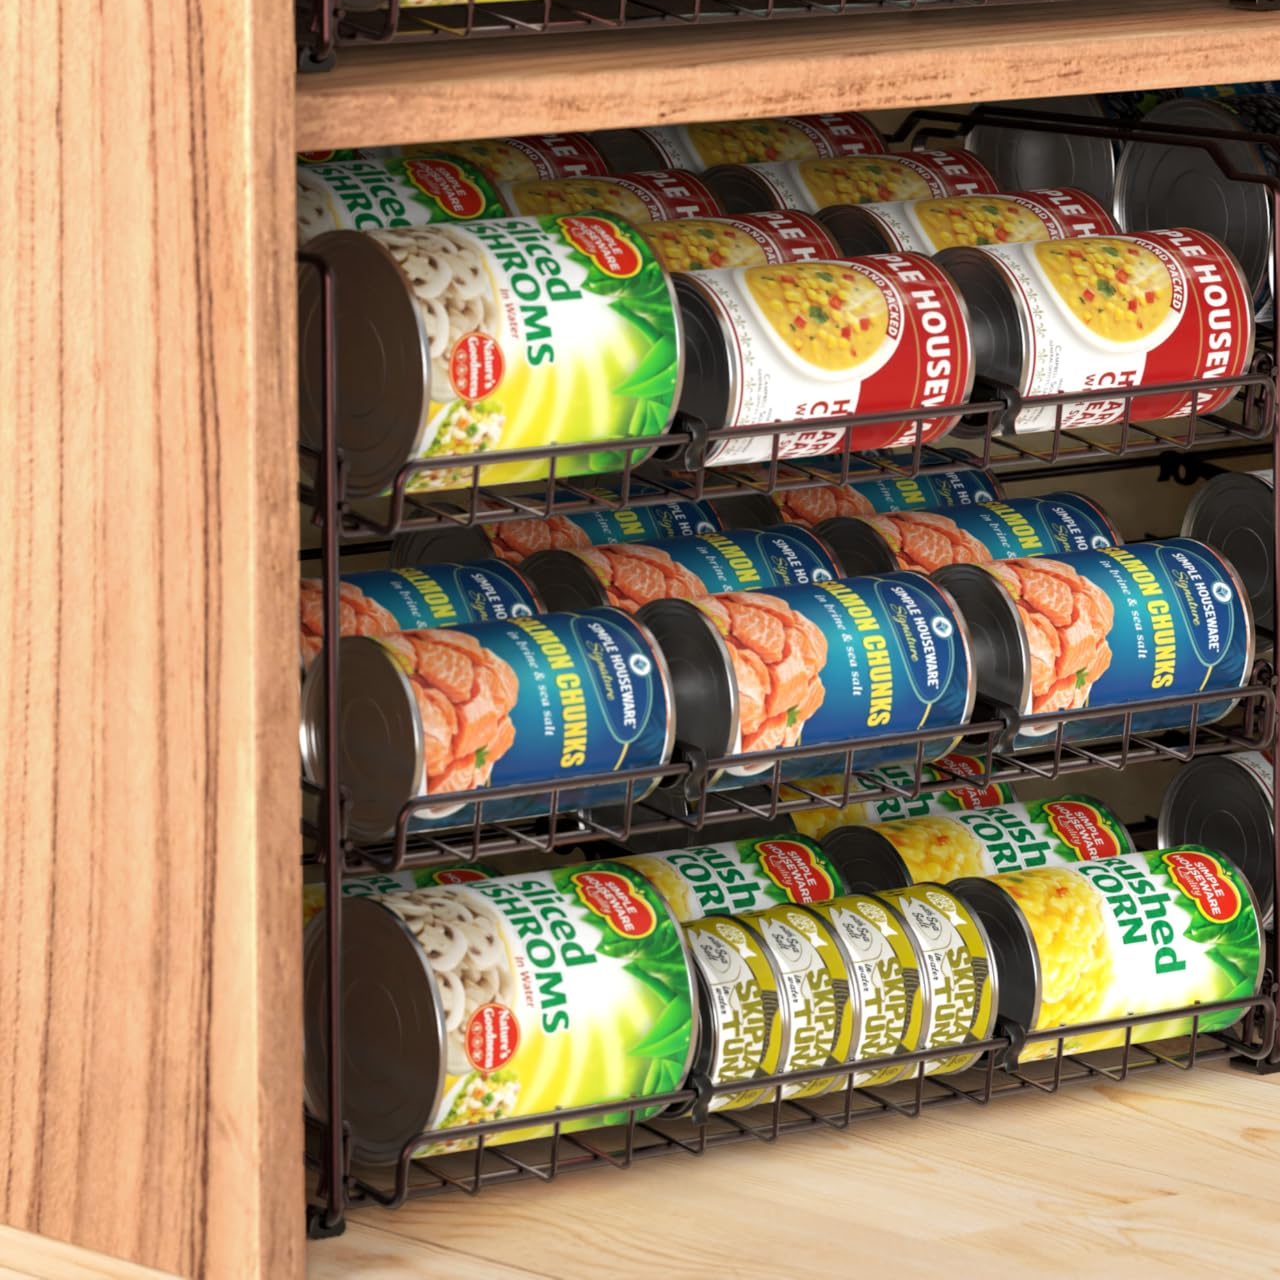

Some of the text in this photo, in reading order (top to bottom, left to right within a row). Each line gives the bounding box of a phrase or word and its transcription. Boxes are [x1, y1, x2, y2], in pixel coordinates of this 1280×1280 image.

[435, 166, 467, 195] SIMPLE
[498, 221, 583, 302] Sliced
[593, 222, 620, 255] SIMPLE
[1136, 239, 1184, 312] HAND PACKED
[505, 303, 520, 340] Water
[851, 265, 899, 340] HAND PACKED
[481, 338, 493, 389] Nature's
[891, 602, 919, 662] Signature
[1107, 568, 1147, 659] brine & sea salt
[1173, 570, 1200, 626] Signature
[1173, 552, 1220, 651] SIMPLE HOUSEWARE
[821, 601, 863, 696] brine & sea salt
[891, 586, 938, 688] SIMPLE HOUSEWARE
[1147, 600, 1177, 690] CHUNKS
[515, 639, 556, 736] brine sea salt
[587, 622, 636, 727] SIMPLE HOUSEWARE
[862, 635, 895, 728] CHUNKS
[556, 673, 586, 769] CHUNKS
[583, 874, 638, 933] SIMPLE HOUSEWARE
[786, 850, 817, 886] SIMPLE
[1172, 853, 1225, 918] SIMPLE HOUSEWARE
[511, 879, 598, 969] Sliced
[1081, 866, 1148, 947] CORN
[518, 969, 536, 1008] Water
[482, 1007, 500, 1070] Goodness
[496, 1008, 511, 1060] Nature's
